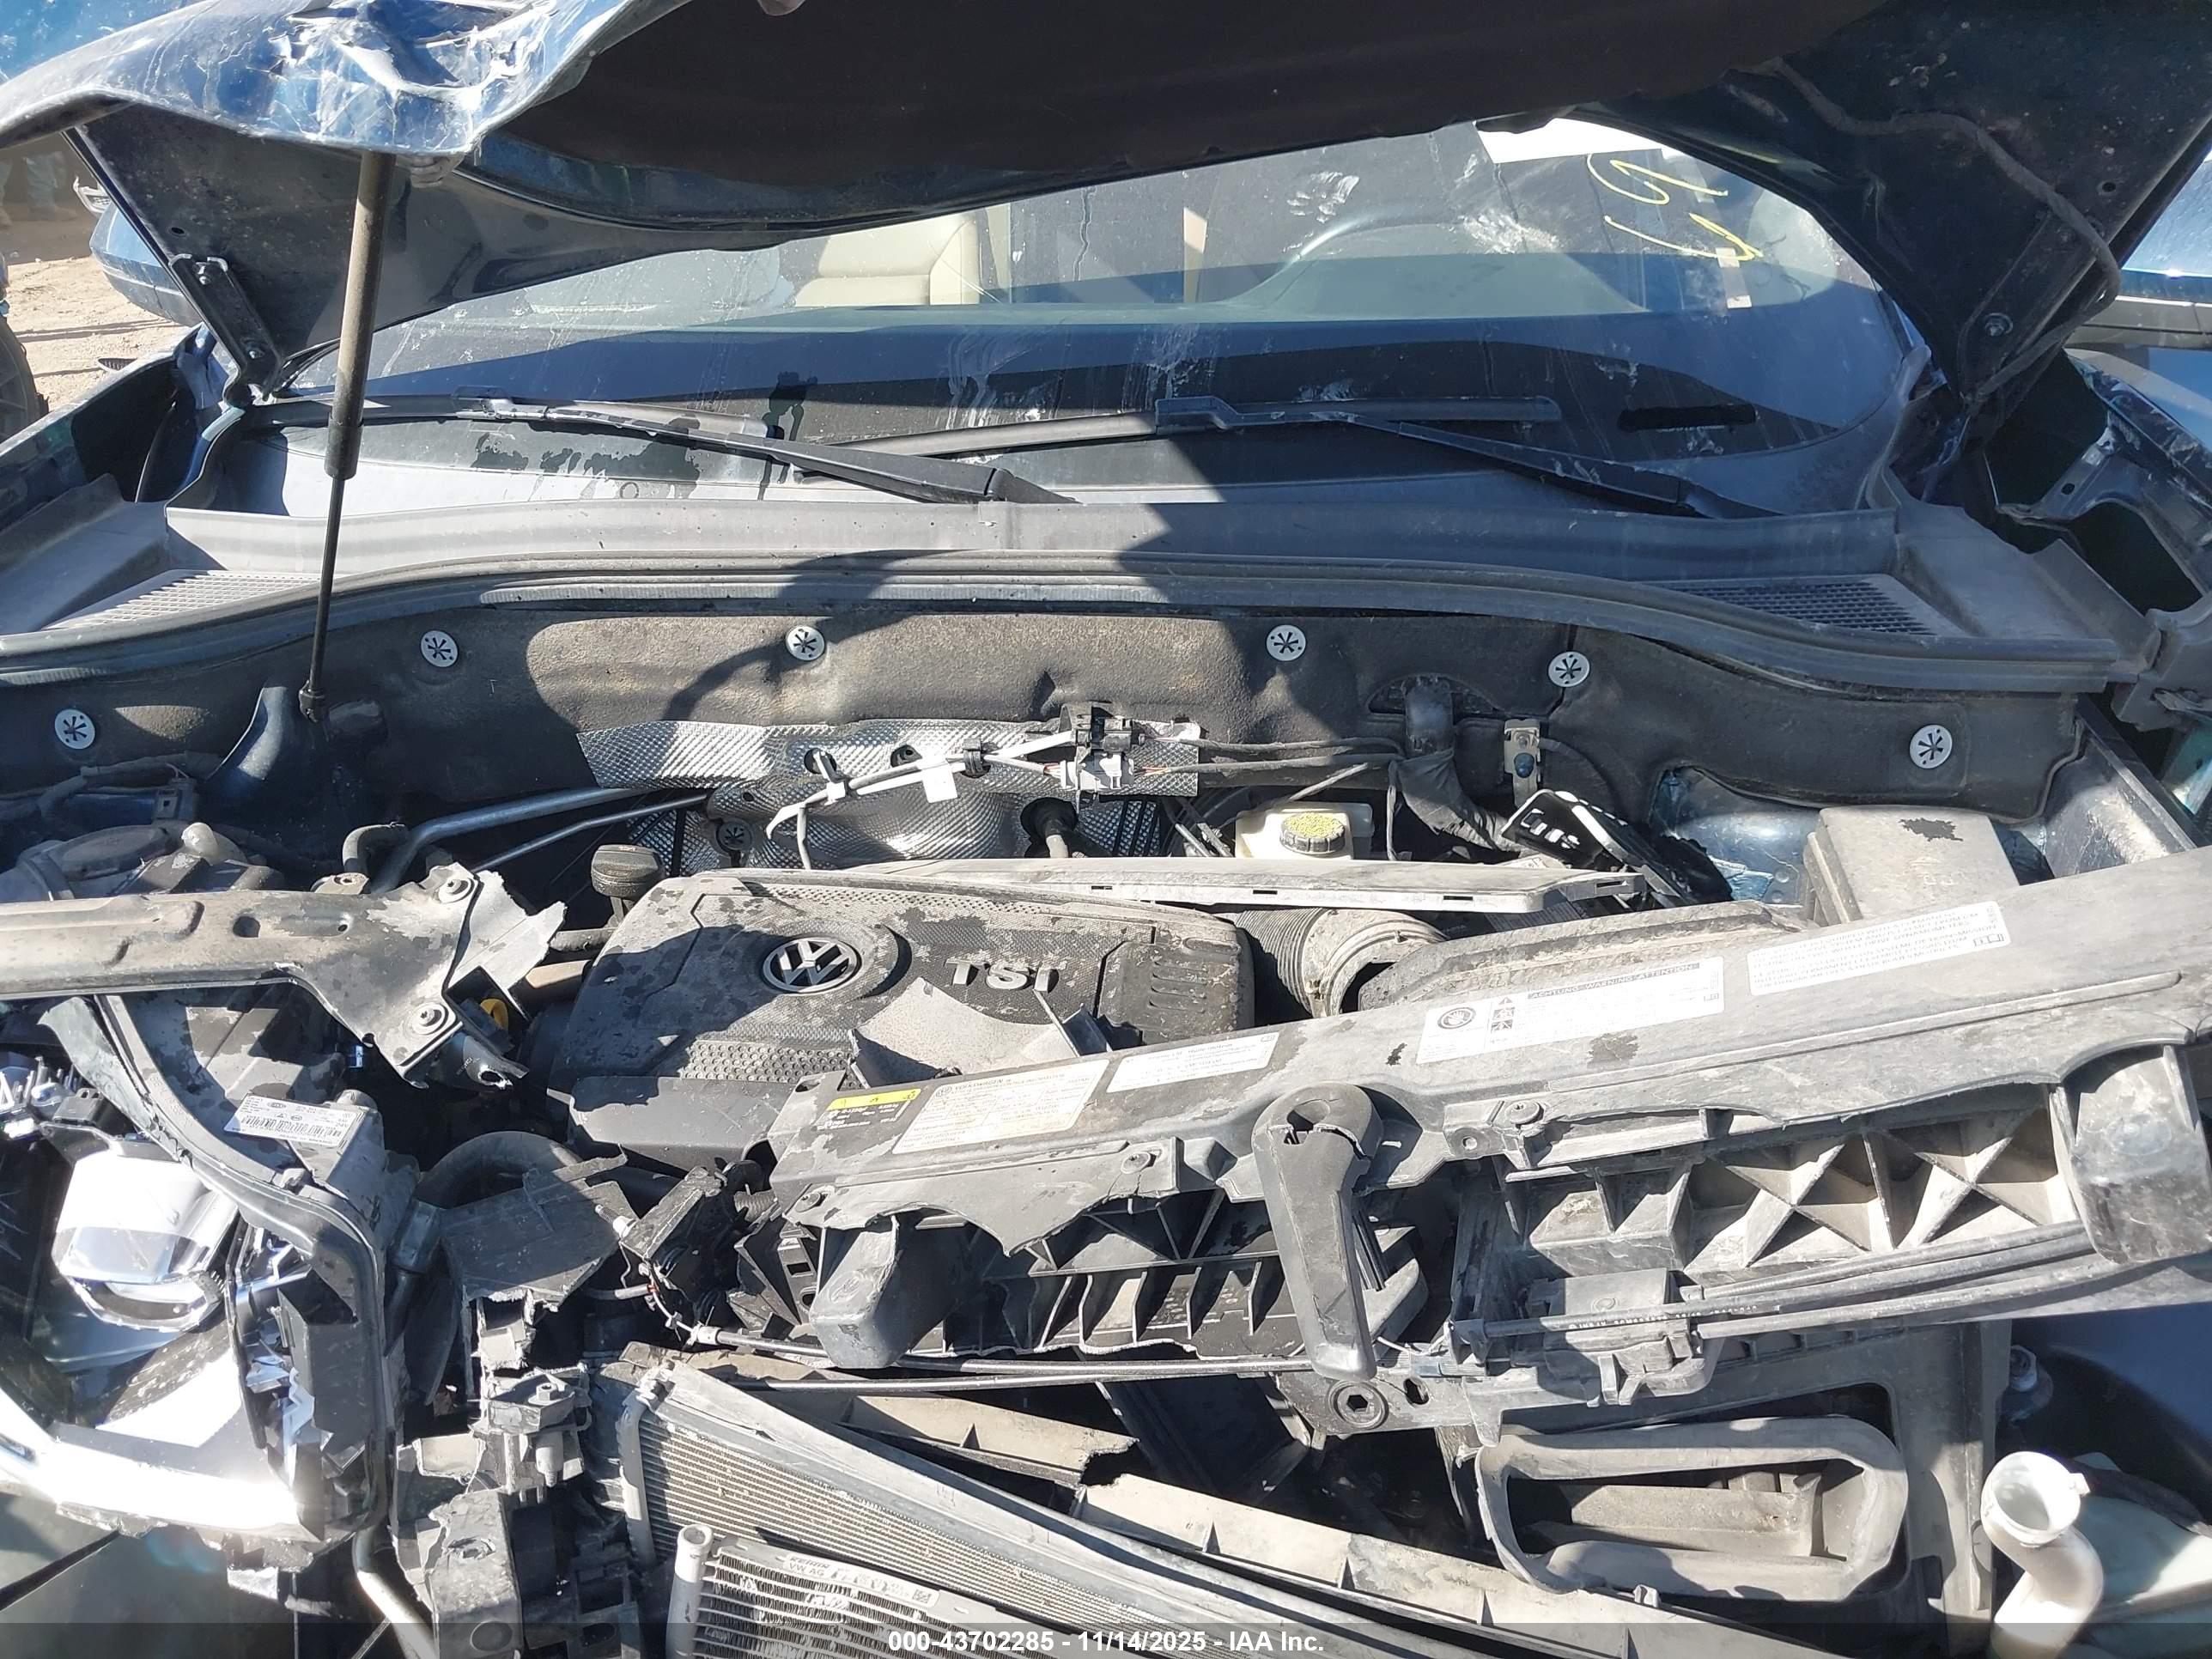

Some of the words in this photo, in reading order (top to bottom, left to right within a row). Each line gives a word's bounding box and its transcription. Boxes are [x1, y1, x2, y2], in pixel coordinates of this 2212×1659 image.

[945, 957, 1054, 993] TSI
[1584, 975, 1635, 990] WARNING
[1638, 964, 1695, 981] ATTENTION
[788, 1563, 806, 1574] VW
[810, 1567, 826, 1577] AG
